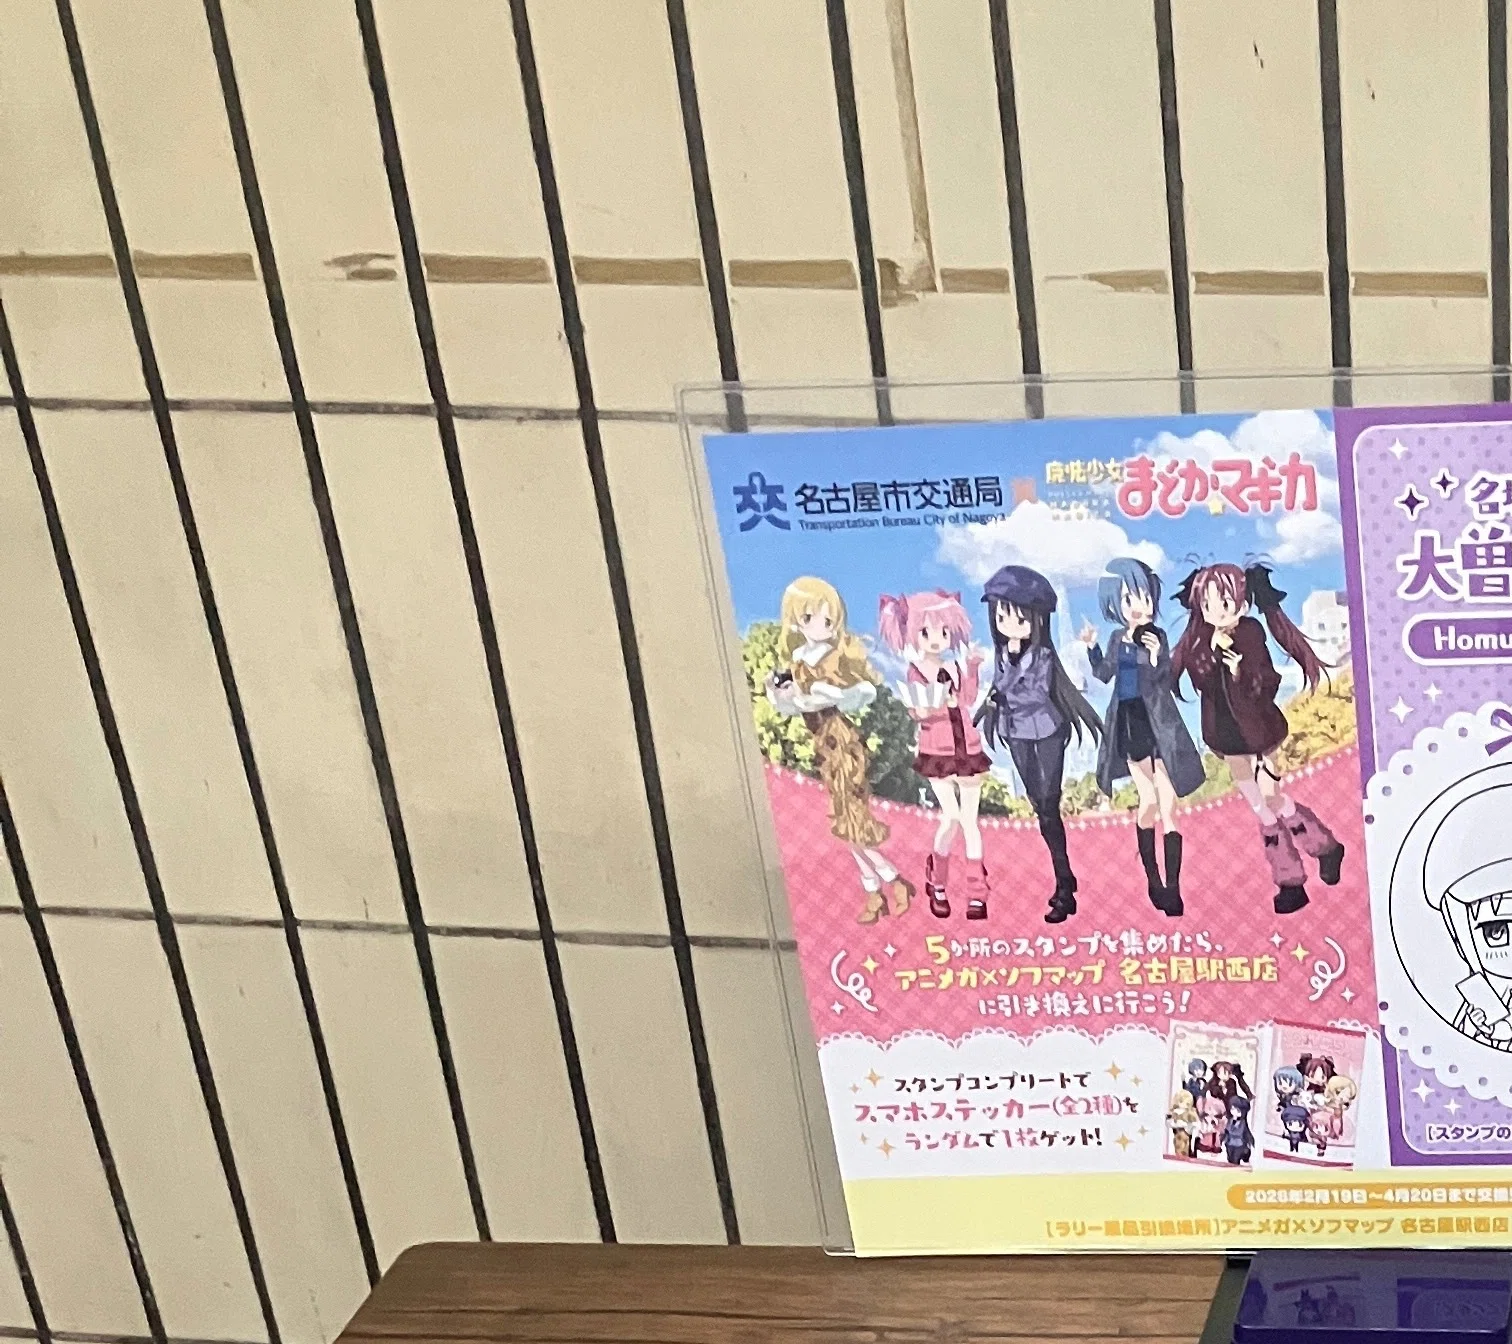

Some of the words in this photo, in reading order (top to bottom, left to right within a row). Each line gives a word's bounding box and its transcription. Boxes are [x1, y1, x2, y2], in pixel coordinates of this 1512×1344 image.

[795, 475, 1003, 515] 名古屋市交通局
[799, 517, 880, 532] Transportation
[882, 515, 921, 528] Bureau
[923, 513, 946, 527] City
[948, 512, 961, 524] of
[962, 512, 1007, 526] Nagoya
[1119, 954, 1278, 986] 名古屋駅西店
[894, 1070, 1091, 1093] スタンプコンプリートで
